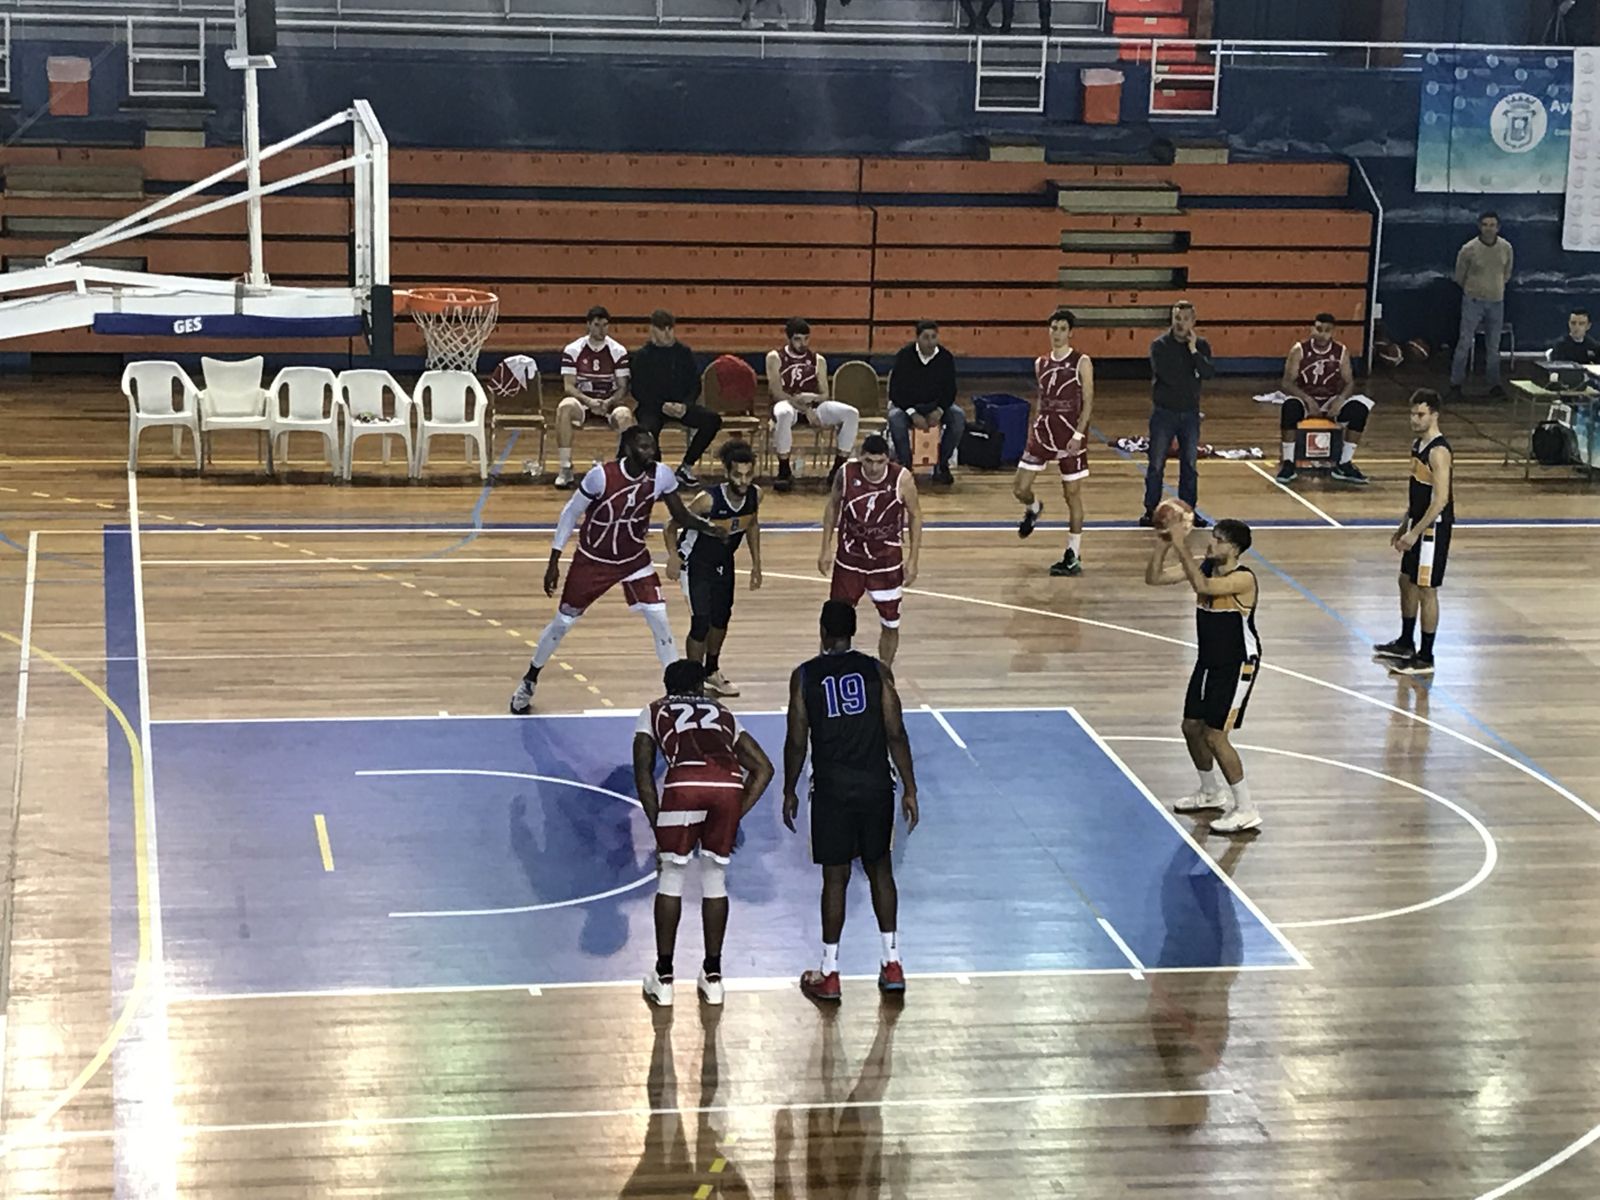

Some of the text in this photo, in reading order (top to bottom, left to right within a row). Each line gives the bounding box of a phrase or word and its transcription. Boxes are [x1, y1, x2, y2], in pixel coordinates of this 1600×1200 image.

[1550, 100, 1573, 115] Ay
[173, 316, 202, 334] GES
[821, 672, 867, 718] 19
[669, 703, 723, 734] 22
